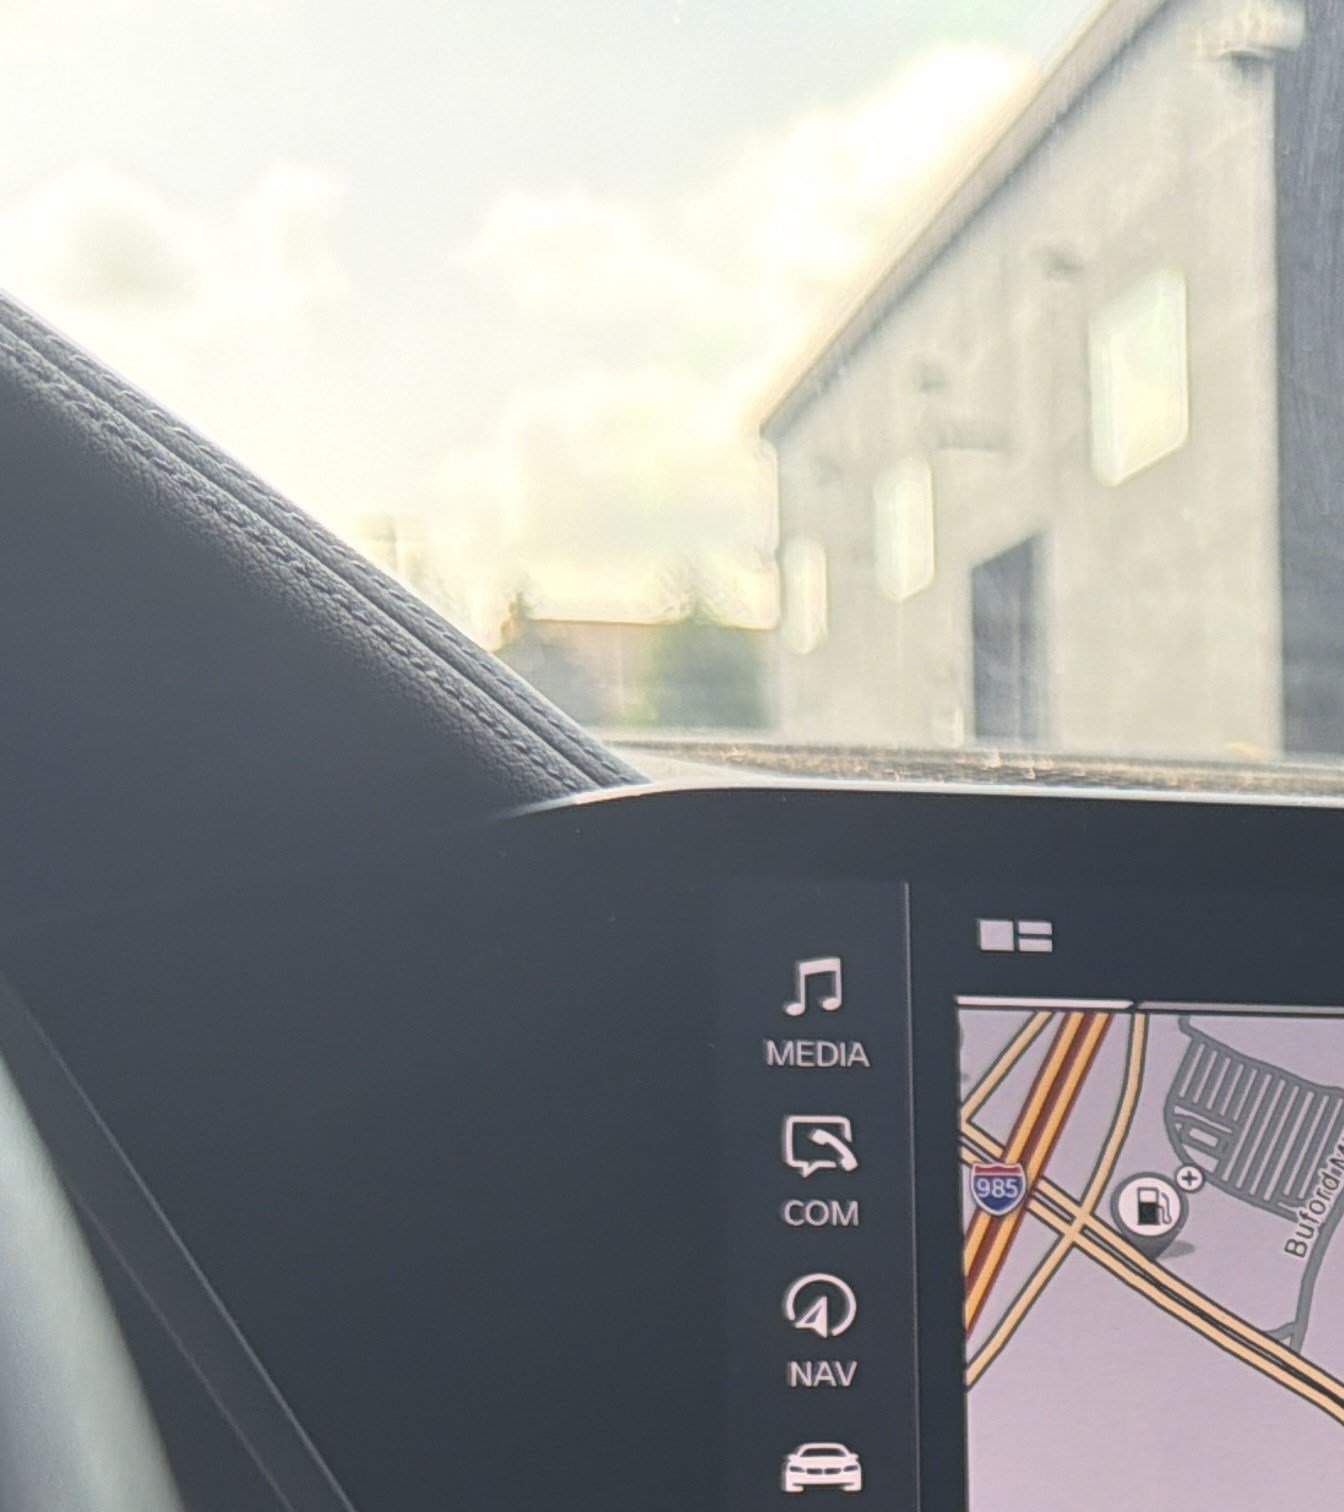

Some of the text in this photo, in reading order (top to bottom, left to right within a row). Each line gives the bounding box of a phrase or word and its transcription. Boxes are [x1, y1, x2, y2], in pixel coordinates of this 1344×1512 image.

[766, 1040, 870, 1067] MEDIA
[976, 1178, 1018, 1198] 985
[782, 1201, 859, 1227] COM
[1284, 1171, 1341, 1258] Buford
[787, 1361, 857, 1388] NAV
